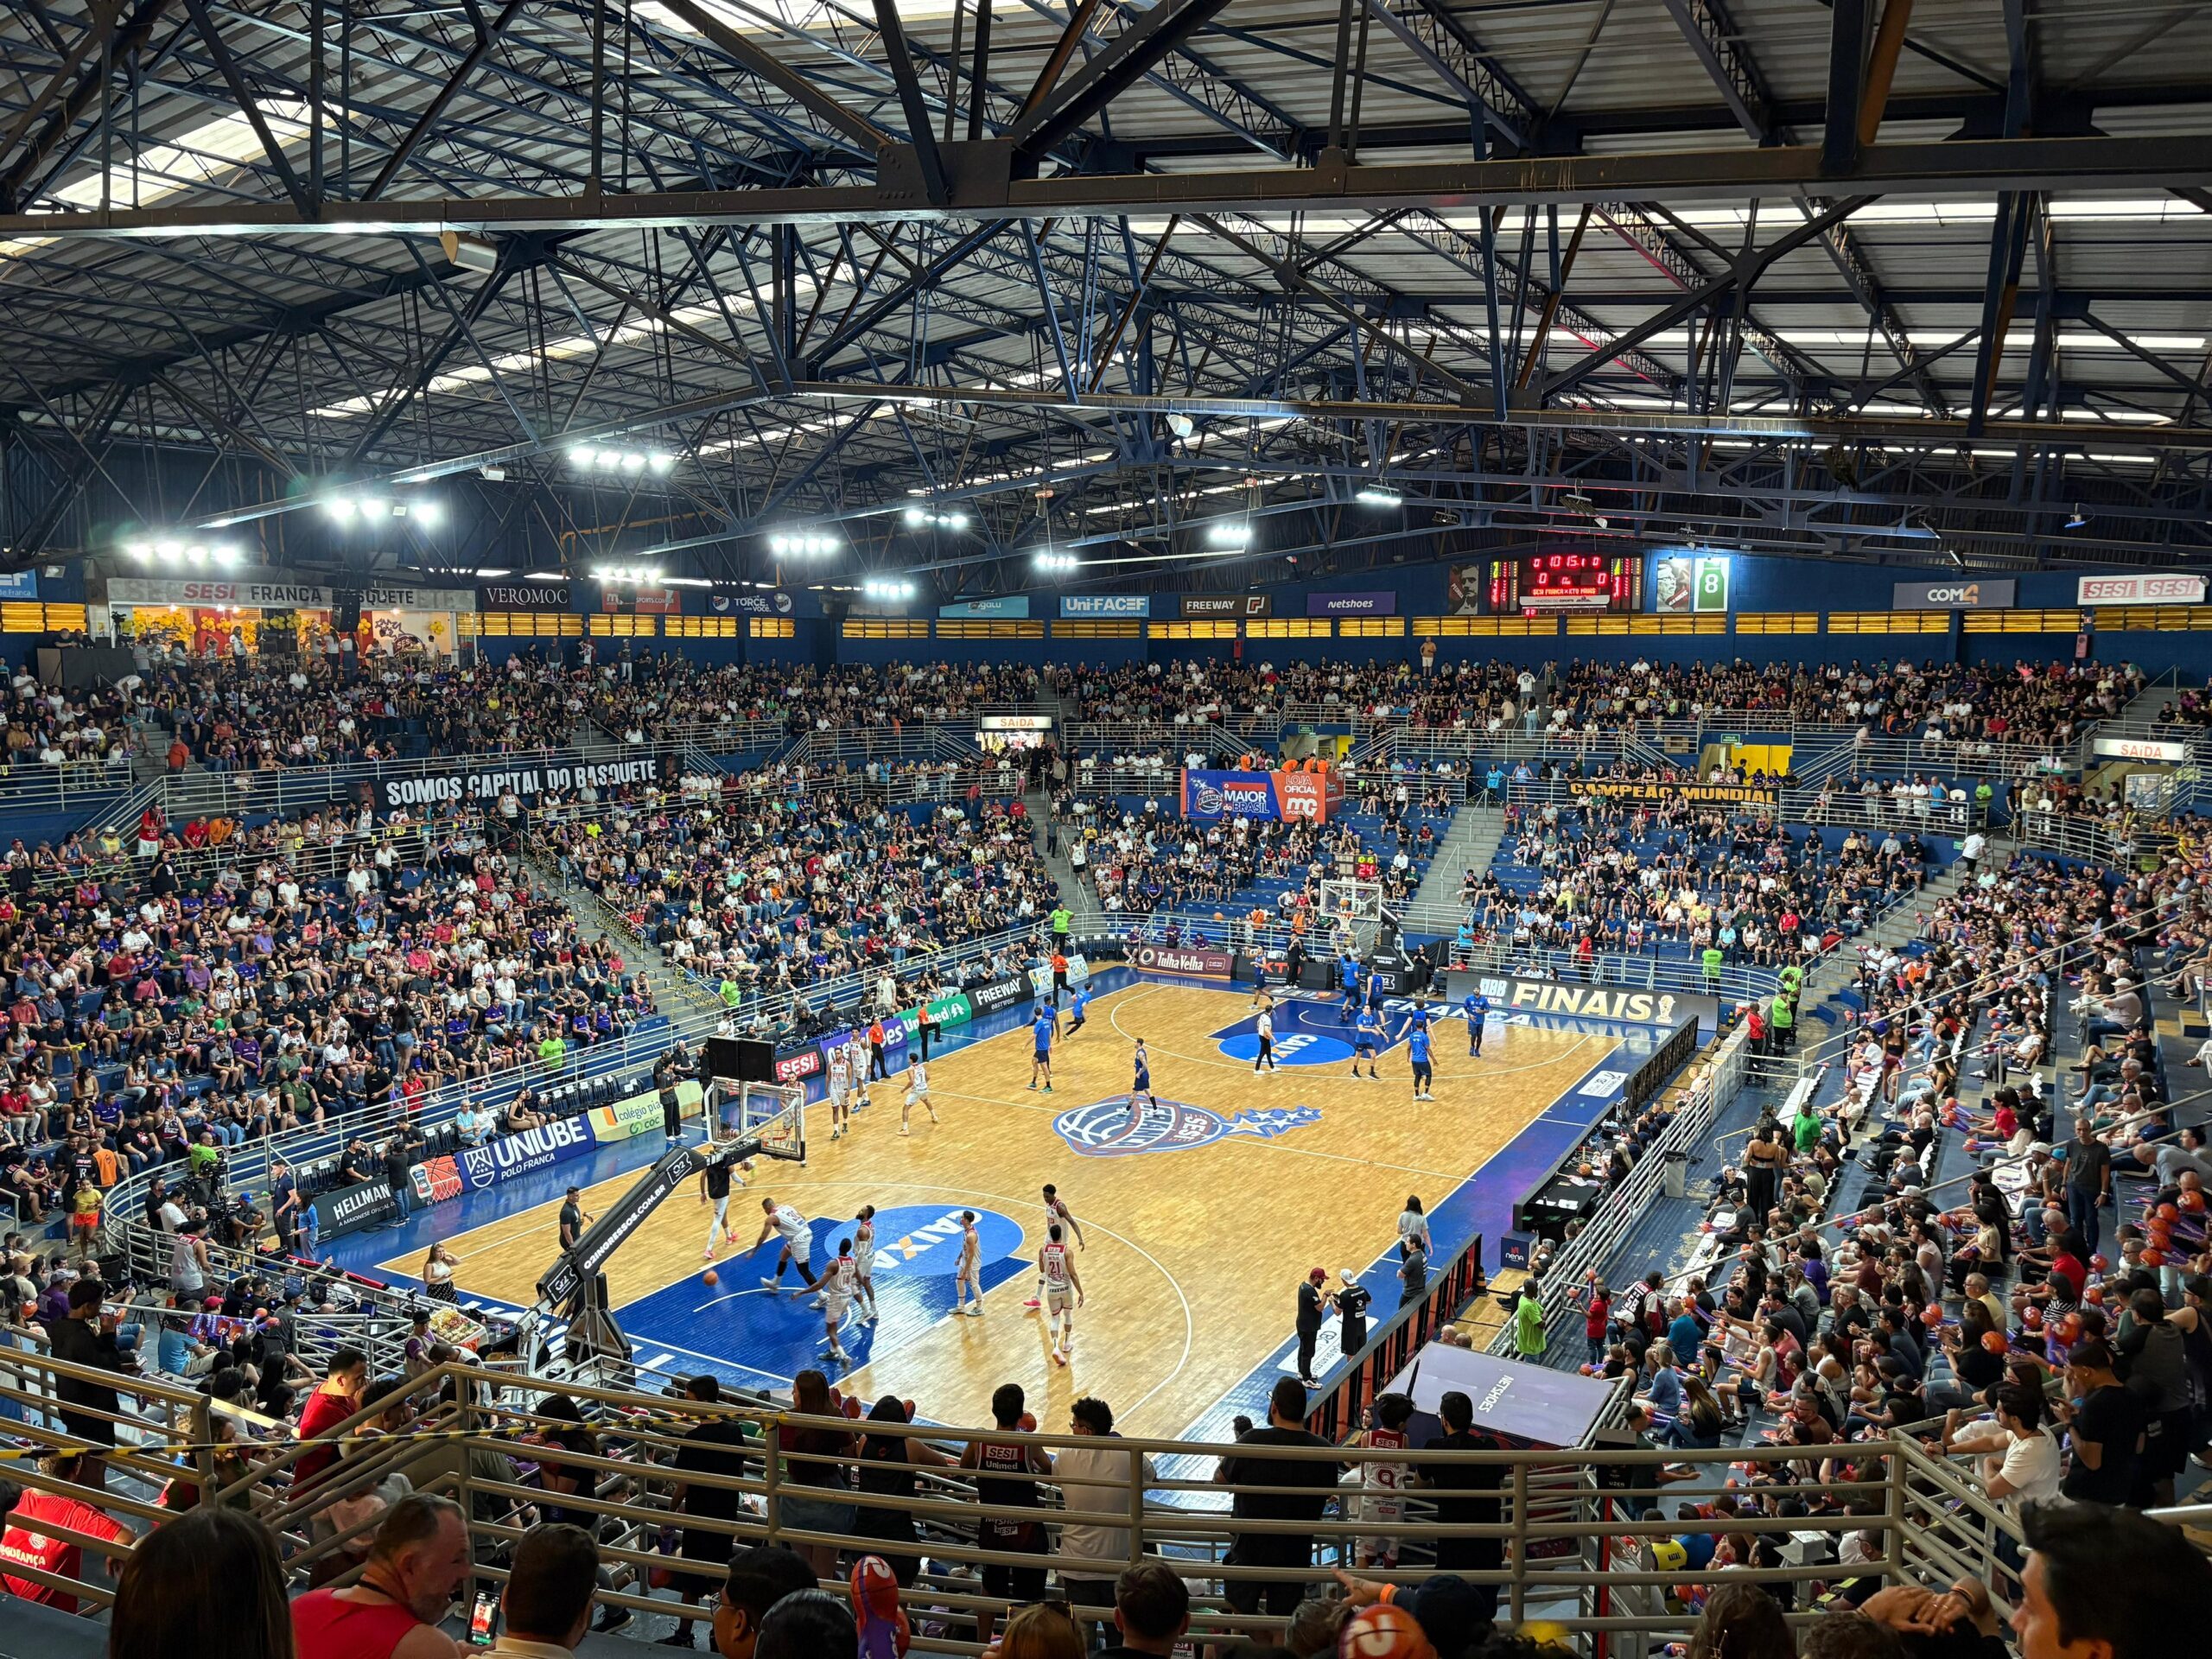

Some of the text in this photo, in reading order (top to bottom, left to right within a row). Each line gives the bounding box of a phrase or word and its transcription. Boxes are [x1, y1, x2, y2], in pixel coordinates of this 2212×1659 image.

[184, 582, 237, 600] SESI
[250, 585, 322, 602] FRANCA
[1705, 573, 1719, 594] 8
[2088, 580, 2195, 597] SESI SESI
[486, 588, 568, 606] VEROMOC
[1065, 597, 1147, 611] Uni-FACEF
[1186, 601, 1235, 610] FREEWAY
[1327, 600, 1374, 609] netshoes
[386, 759, 658, 805] SOMOS CAPITAL DO BASQUETE
[1286, 774, 1313, 785] LOJA
[1224, 790, 1267, 804] MAIOR
[1284, 785, 1318, 794] OFICIAL
[1570, 782, 1777, 804] CAMPEÃO MUNDIAL
[1233, 801, 1270, 814] BRASIL
[1358, 864, 1374, 876] 24
[976, 977, 1022, 1006] FREEWAY
[1510, 982, 1654, 1021] FINAIS
[780, 1055, 815, 1079] SESI
[619, 1105, 647, 1121] colégio
[1178, 1116, 1209, 1139] SESI
[493, 1116, 588, 1167] UNIUBE
[500, 1153, 556, 1180] POLO FRANCA
[333, 1182, 391, 1221] HELLMAN
[343, 1211, 371, 1225] MAIONESE
[371, 1203, 390, 1215] OFICIAL
[1049, 1262, 1061, 1274] 21
[1478, 1374, 1515, 1413] NETSHOES
[1377, 1439, 1396, 1447] SESI
[988, 1447, 1015, 1459] SESI
[985, 1460, 1018, 1470] Unimed
